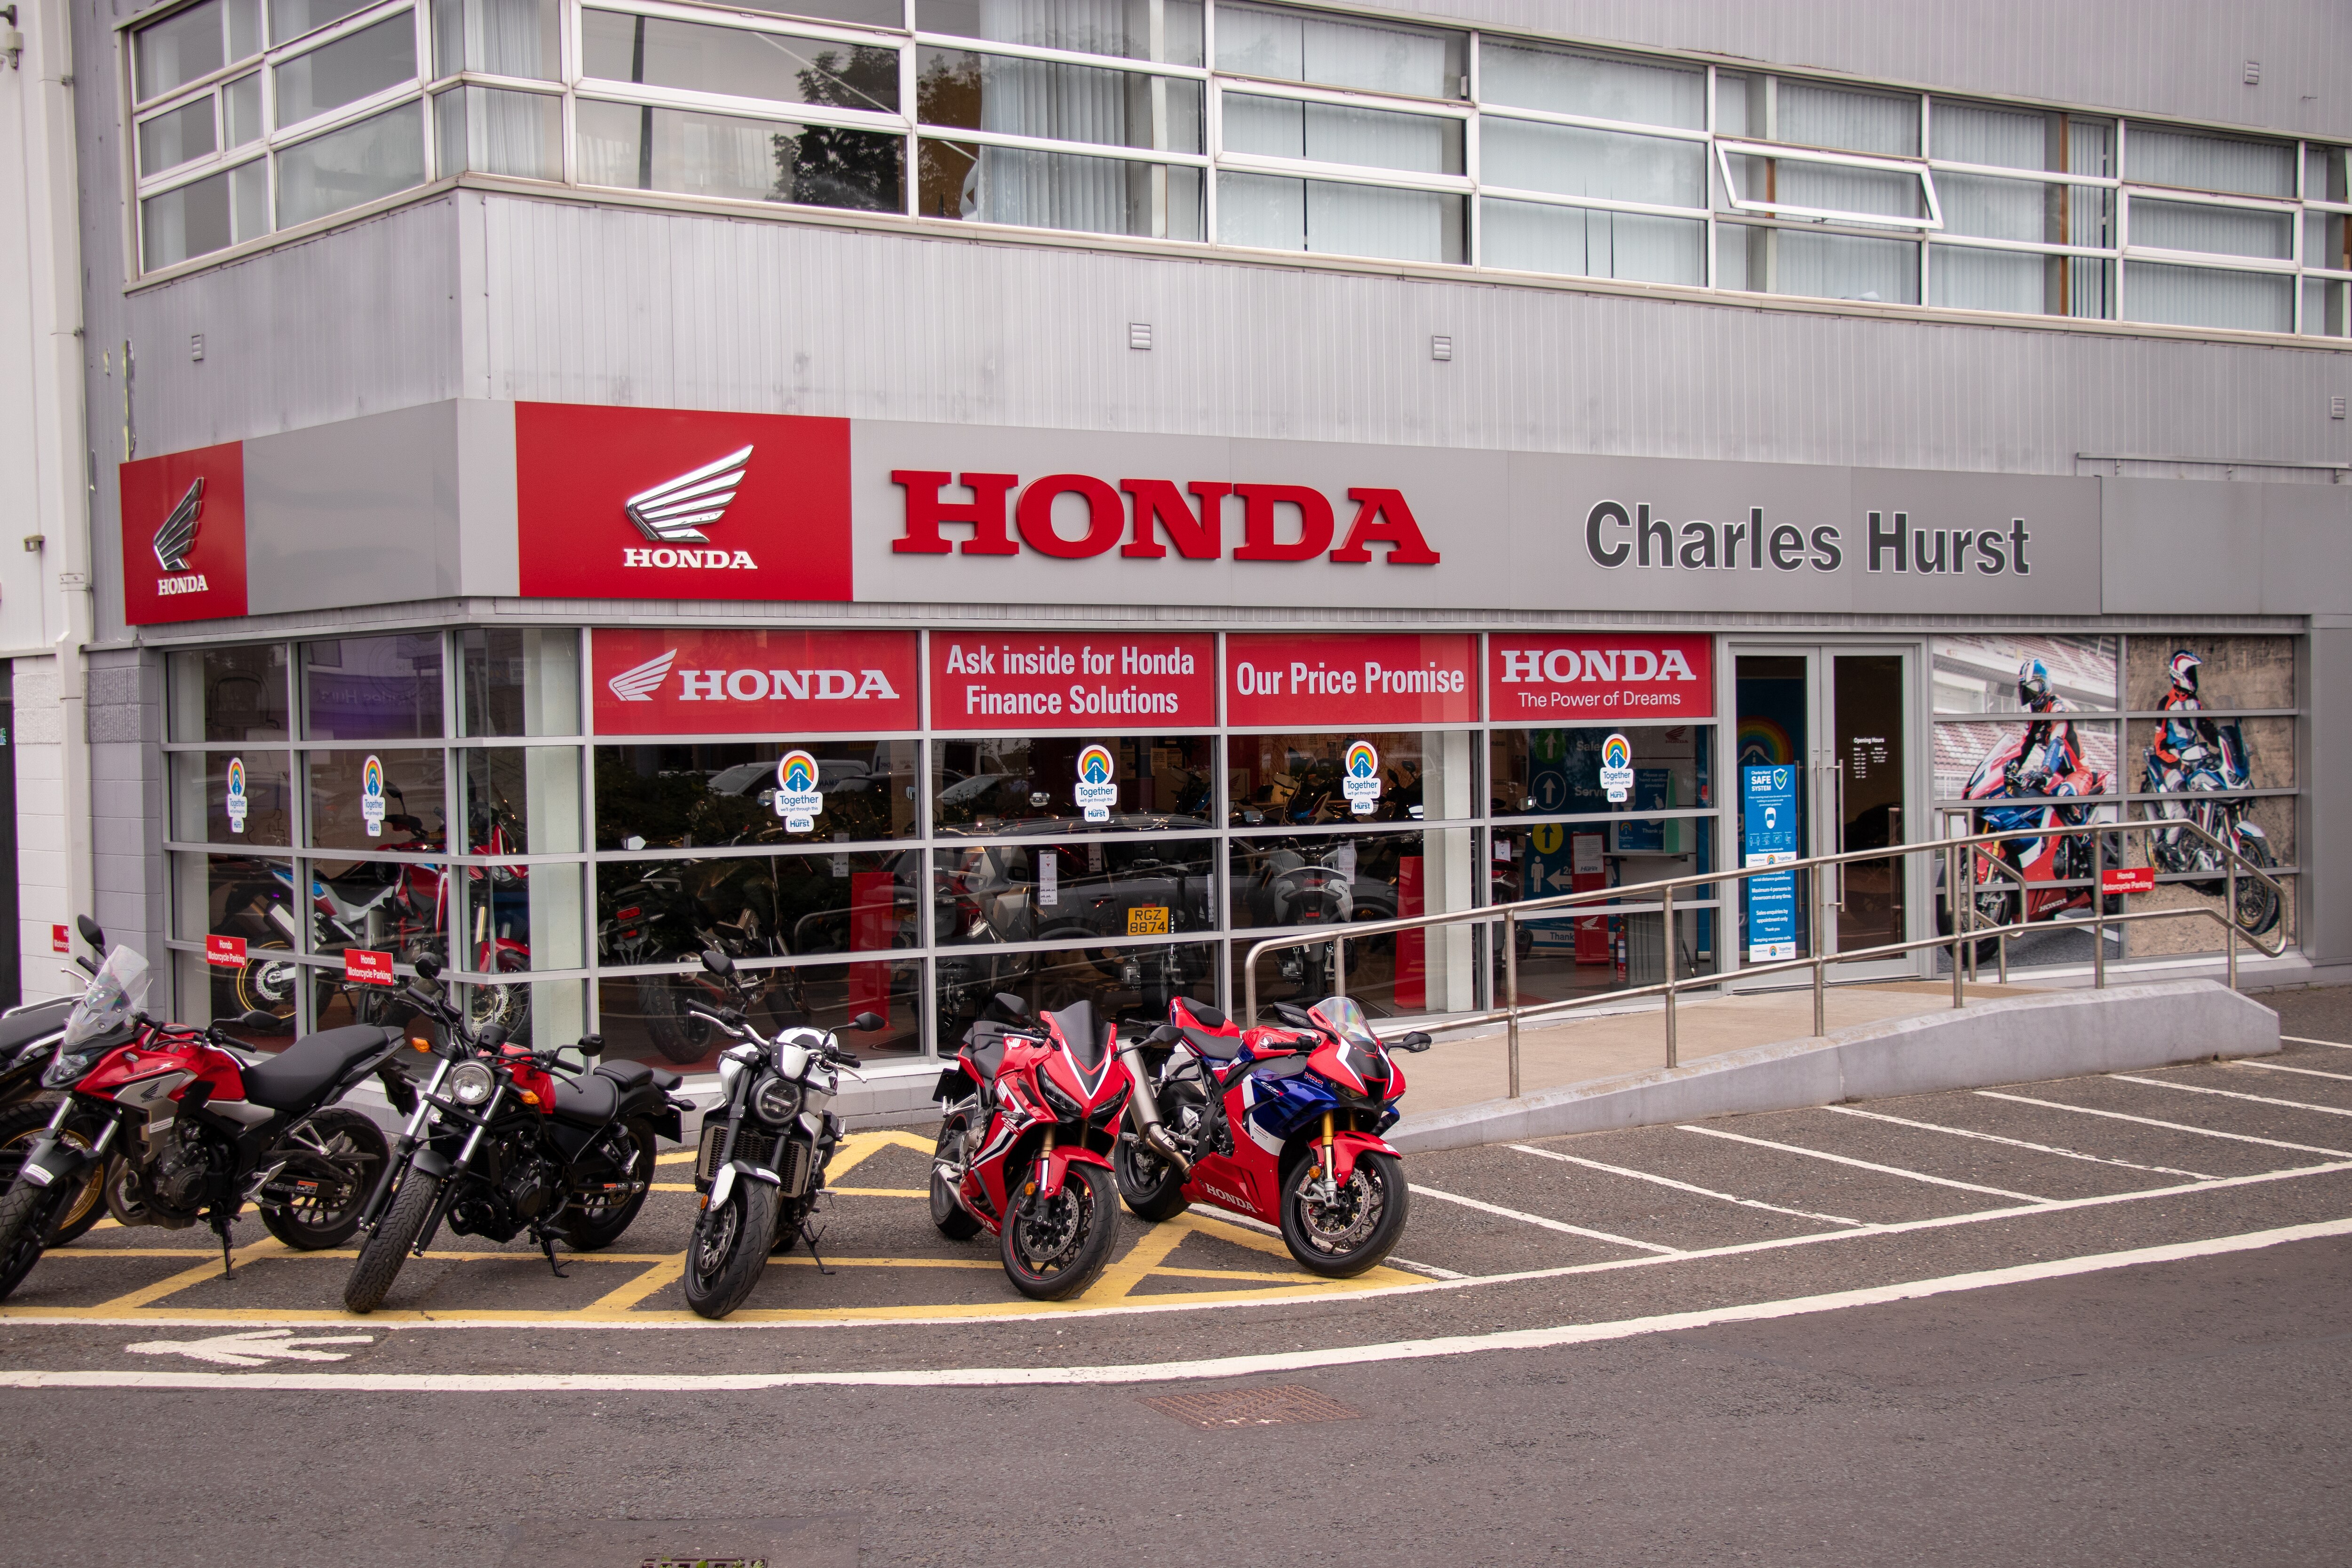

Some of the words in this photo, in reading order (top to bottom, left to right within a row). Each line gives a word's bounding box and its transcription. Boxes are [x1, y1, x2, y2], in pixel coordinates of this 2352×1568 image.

[891, 470, 1440, 565] HONDA
[1585, 500, 1843, 573] Charles
[1866, 511, 2030, 576] Hurst
[623, 548, 758, 569] HONDA
[158, 575, 209, 596] HONDA
[946, 645, 995, 675] Ask
[1003, 645, 1075, 675] inside
[1081, 646, 1114, 675] for
[1122, 646, 1194, 675] Honda
[1501, 649, 1697, 683] HONDA
[678, 669, 900, 701] HONDA
[1237, 661, 1282, 695] Our
[1290, 662, 1357, 694] Price
[1365, 661, 1464, 693] Promise
[967, 685, 1062, 715] Finance
[1070, 685, 1178, 714] Solutions
[1518, 692, 1547, 707] The
[1551, 692, 1600, 707] Power
[1603, 691, 1620, 706] of
[1623, 691, 1681, 706] Dreams
[1576, 741, 1602, 751] Sale
[1603, 771, 1630, 781] Together
[1751, 776, 1771, 785] SAFE
[1079, 787, 1113, 797] Together
[1347, 781, 1377, 790] Together
[230, 798, 246, 809] Together
[365, 799, 383, 810] Together
[779, 795, 818, 806] Together
[2117, 871, 2136, 880] Honda
[2131, 880, 2153, 890] Parking
[2038, 898, 2067, 912] HONDA
[1135, 909, 1161, 921] RGZ
[1130, 922, 1166, 933] 8874
[1550, 931, 1575, 940] Thank
[219, 939, 233, 949] Honda
[208, 950, 229, 962] Motorcycle
[230, 953, 245, 965] Parking
[360, 954, 376, 965] Honda
[348, 966, 373, 979] Motorcycle
[373, 969, 391, 983] Parking
[1304, 1071, 1324, 1088] HRC
[142, 1095, 164, 1104] HONDA
[1001, 1117, 1019, 1133] CBR
[1300, 1176, 1310, 1190] brembo
[1205, 1182, 1258, 1214] HONDA
